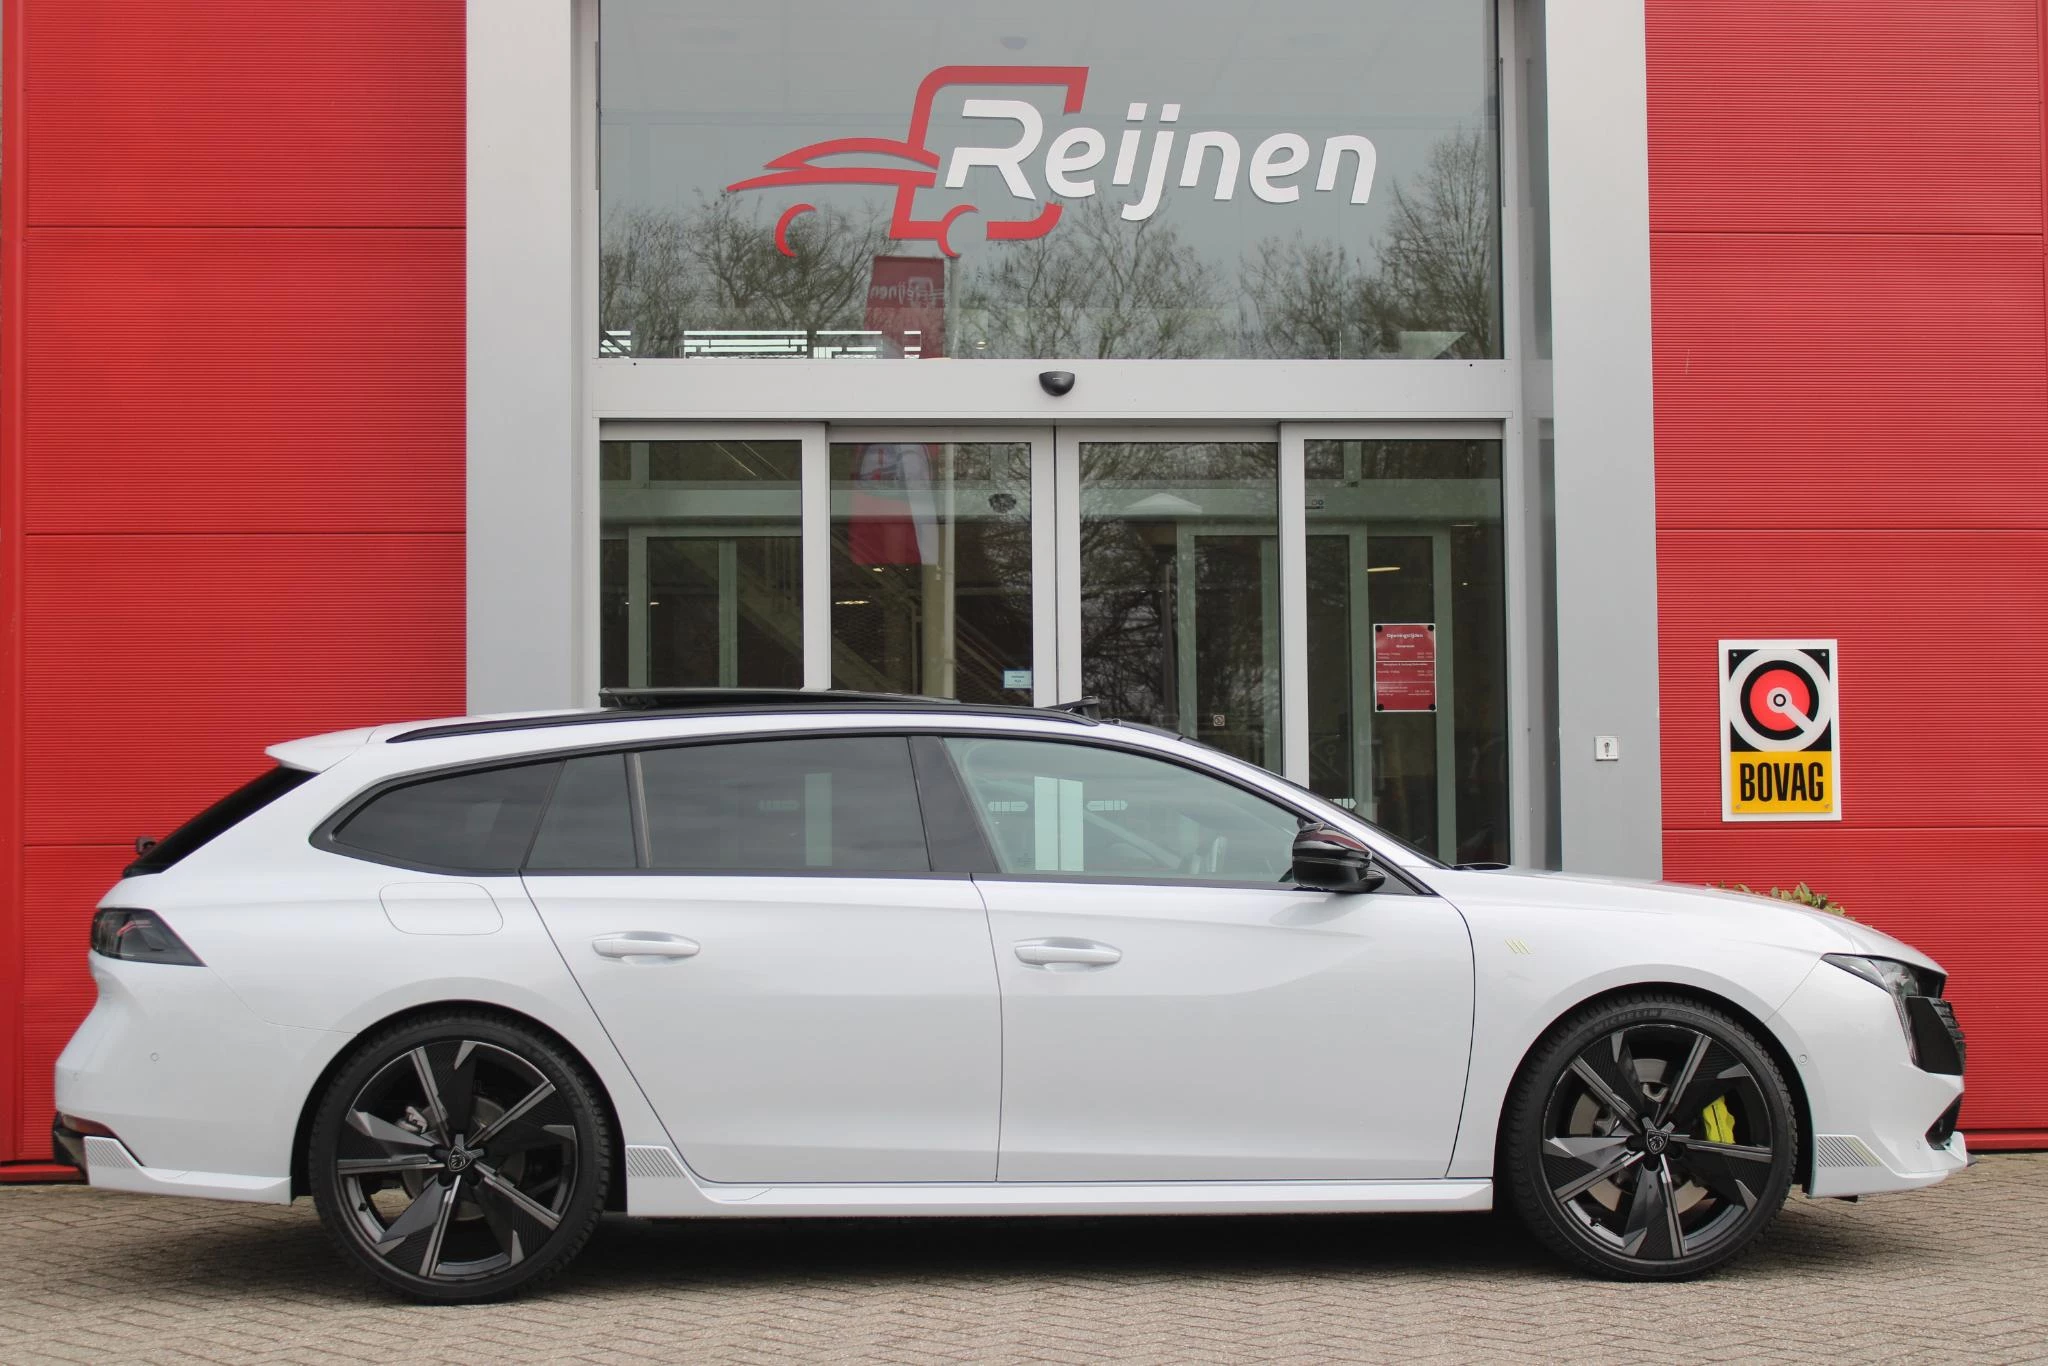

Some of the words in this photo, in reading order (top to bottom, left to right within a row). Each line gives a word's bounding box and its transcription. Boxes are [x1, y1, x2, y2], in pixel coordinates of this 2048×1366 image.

[945, 99, 1378, 221] Reijnen
[1740, 762, 1824, 802] BOVAG
[1593, 1009, 1659, 1030] MICHELIN
